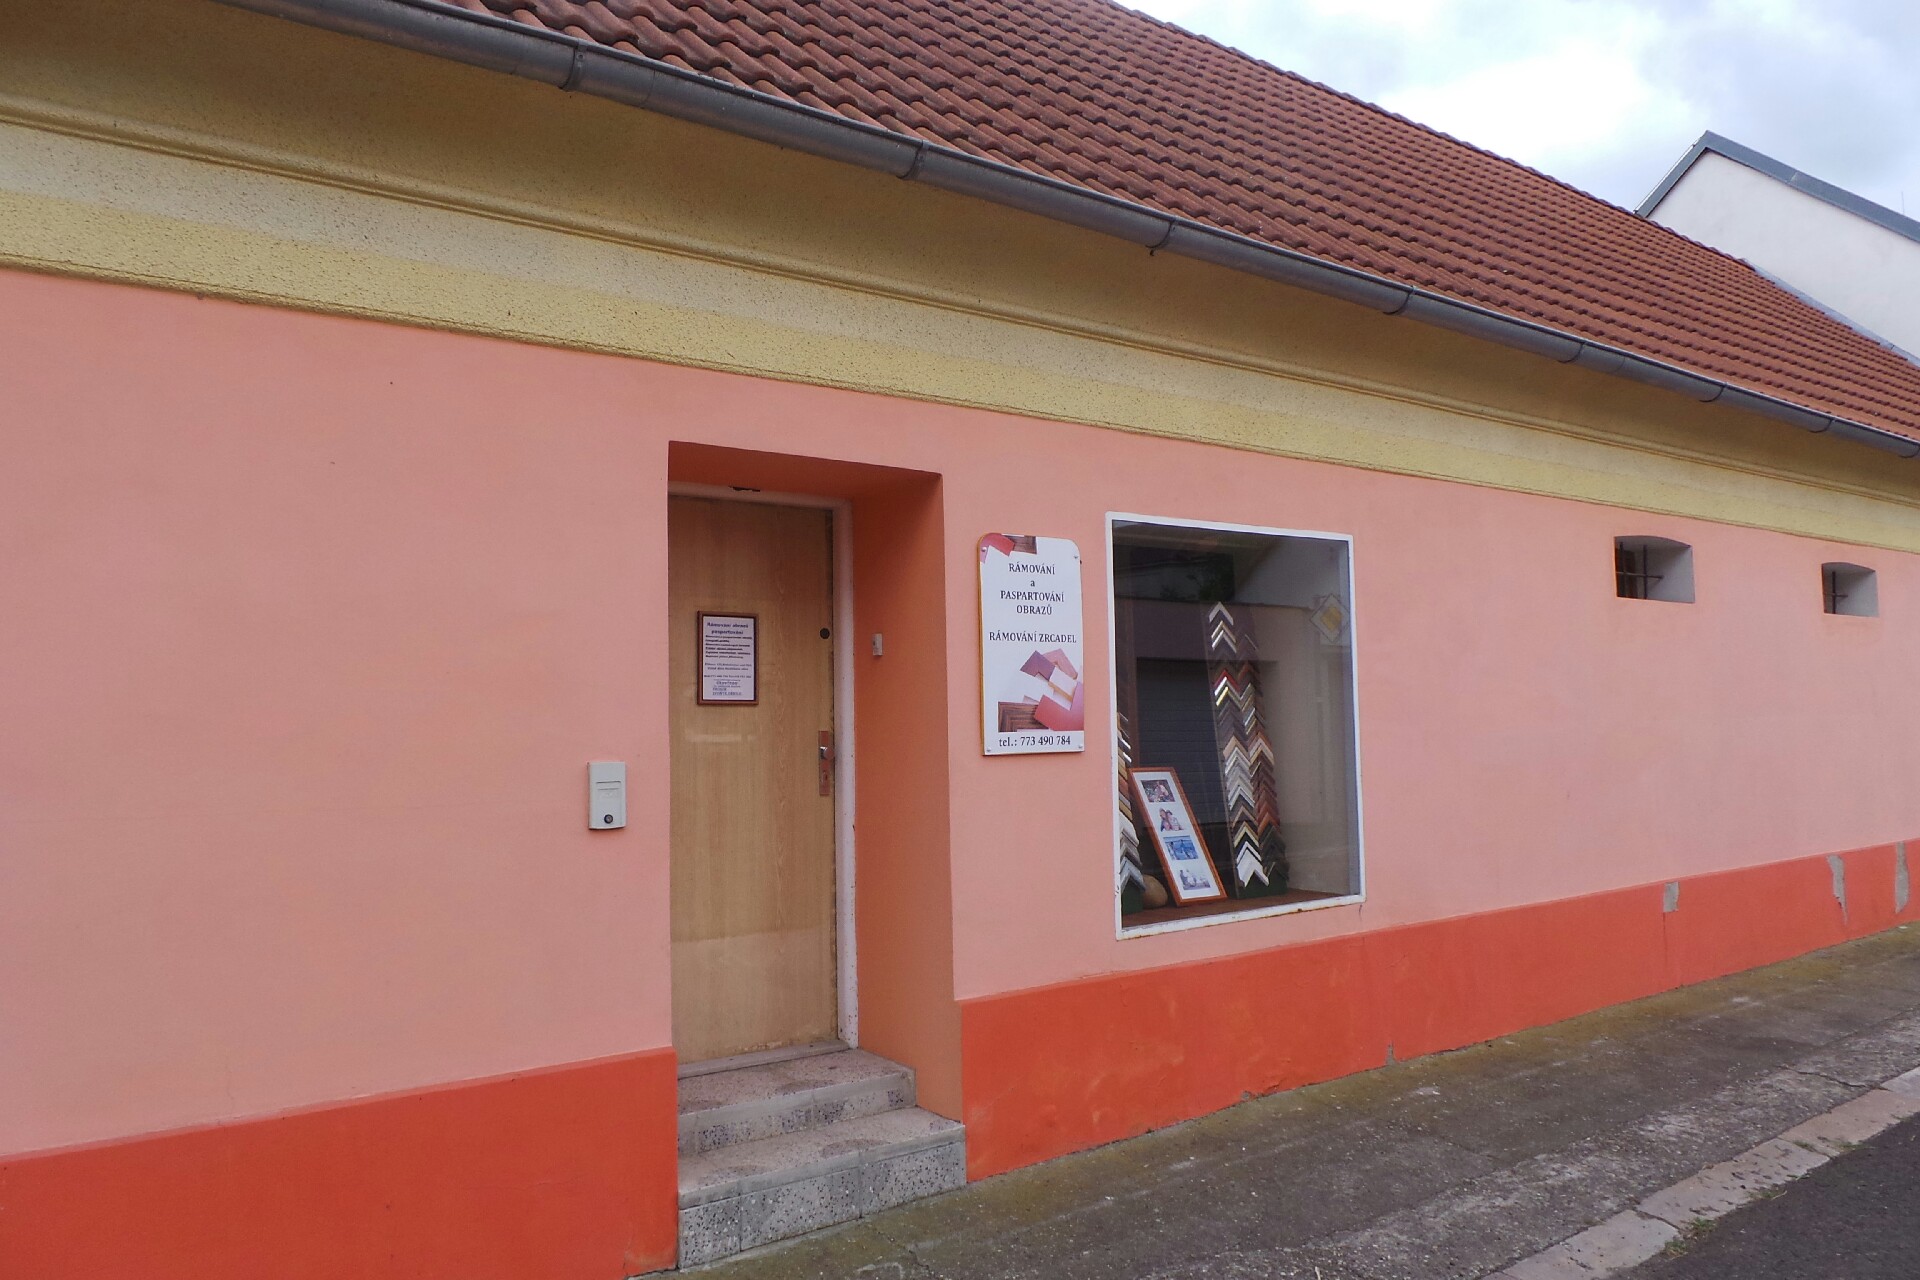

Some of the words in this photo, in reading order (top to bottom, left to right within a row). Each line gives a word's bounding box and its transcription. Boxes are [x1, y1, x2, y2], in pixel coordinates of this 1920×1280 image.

[1008, 561, 1055, 575] RÁMOVÁNÍ
[1000, 590, 1065, 603] PASPARTOVÁNÍ
[1016, 604, 1052, 616] OBRAZŮ
[989, 630, 1037, 643] RÁMOVÁNÍ
[1038, 633, 1077, 643] ZRCADEL
[998, 737, 1018, 747] tel.:
[1020, 736, 1036, 746] 773
[1038, 735, 1054, 746] 490
[1056, 735, 1071, 745] 784
